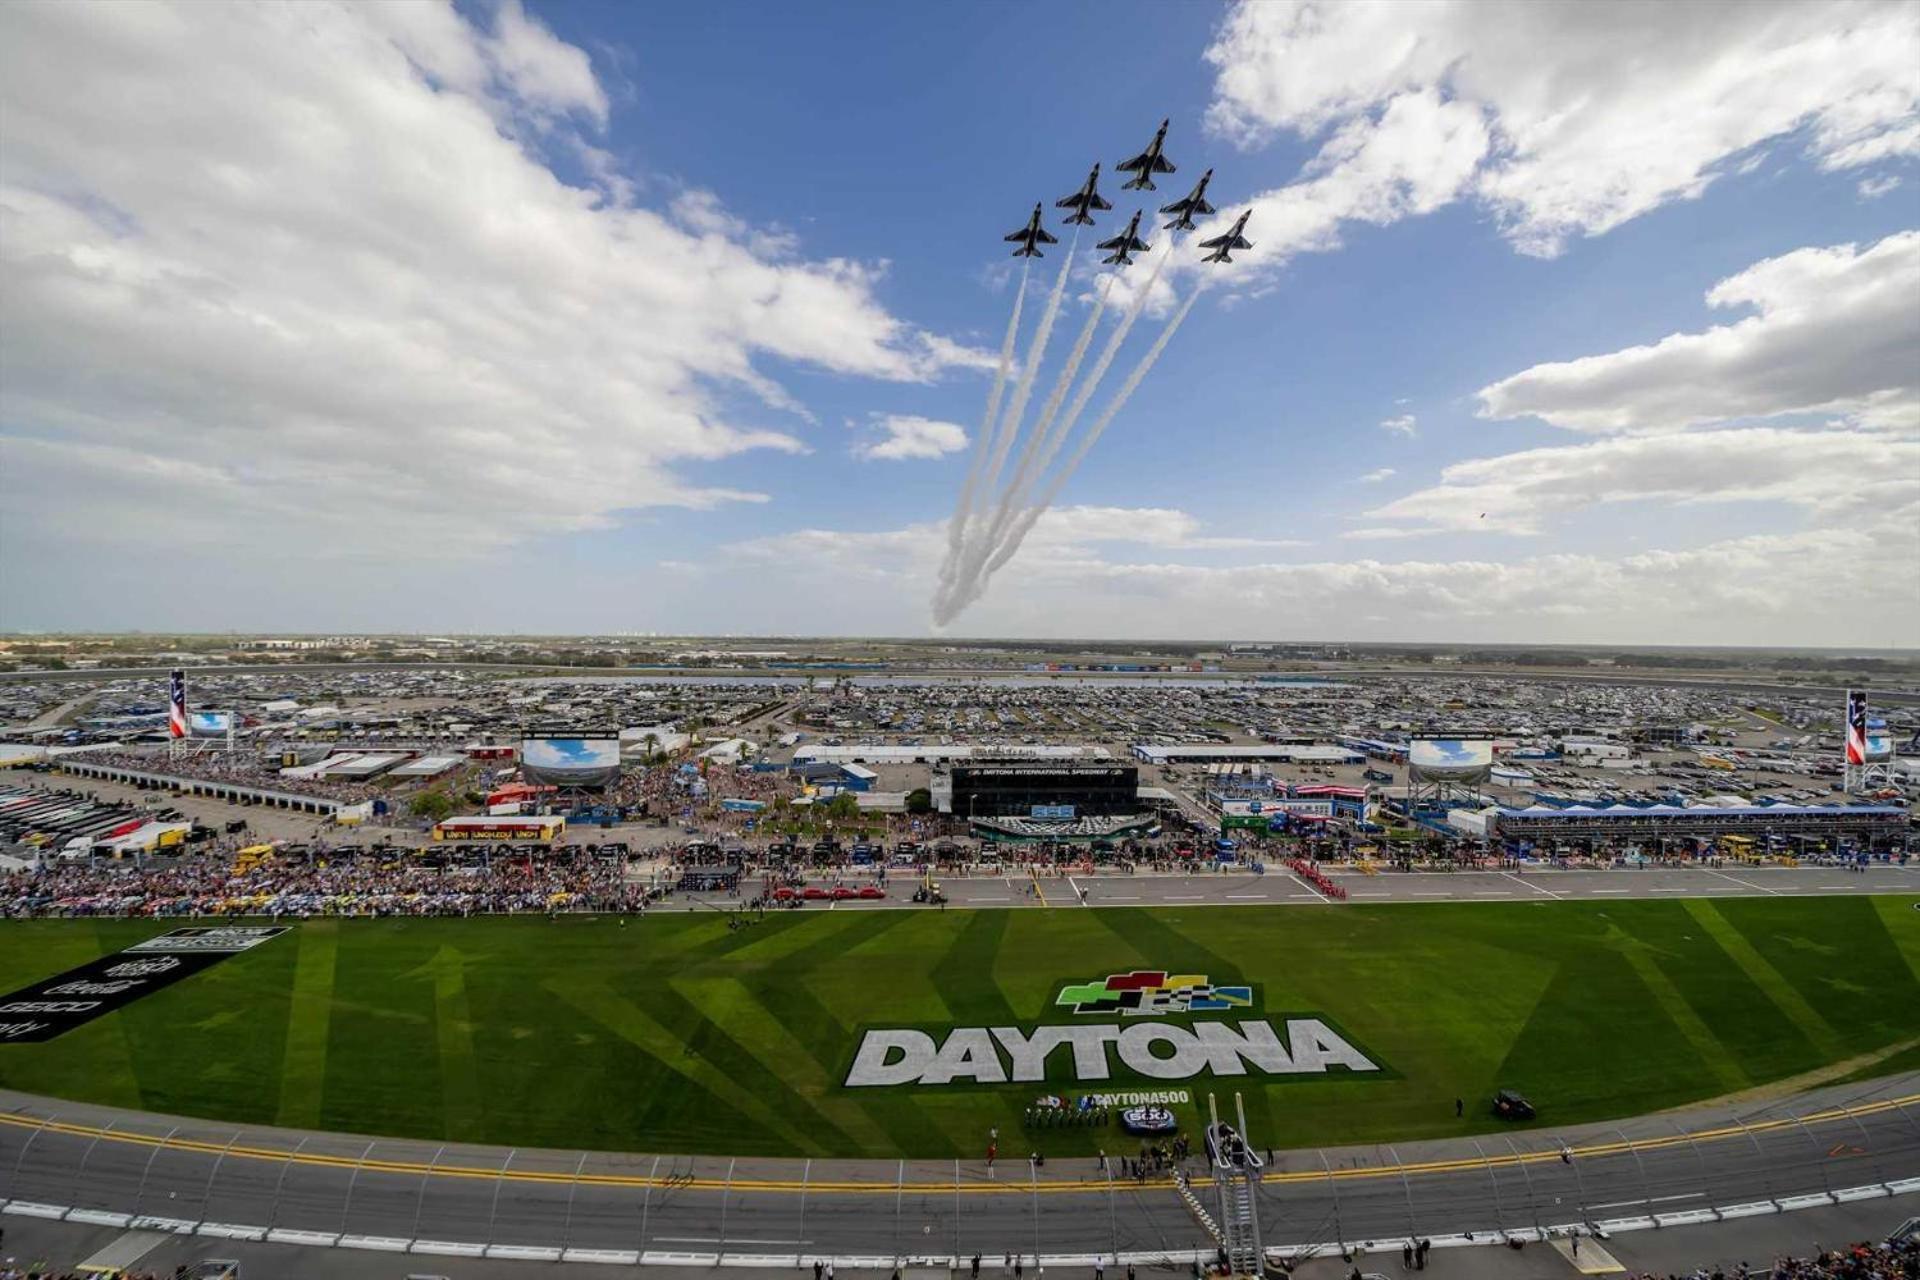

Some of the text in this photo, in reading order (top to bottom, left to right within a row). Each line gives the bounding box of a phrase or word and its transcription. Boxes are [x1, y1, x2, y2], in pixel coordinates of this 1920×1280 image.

[983, 768, 1108, 776] DAYTONA INTERNATIONAL SPEEDWAY
[0, 1001, 102, 1013] GEICO
[844, 1018, 1380, 1087] DAYTONA
